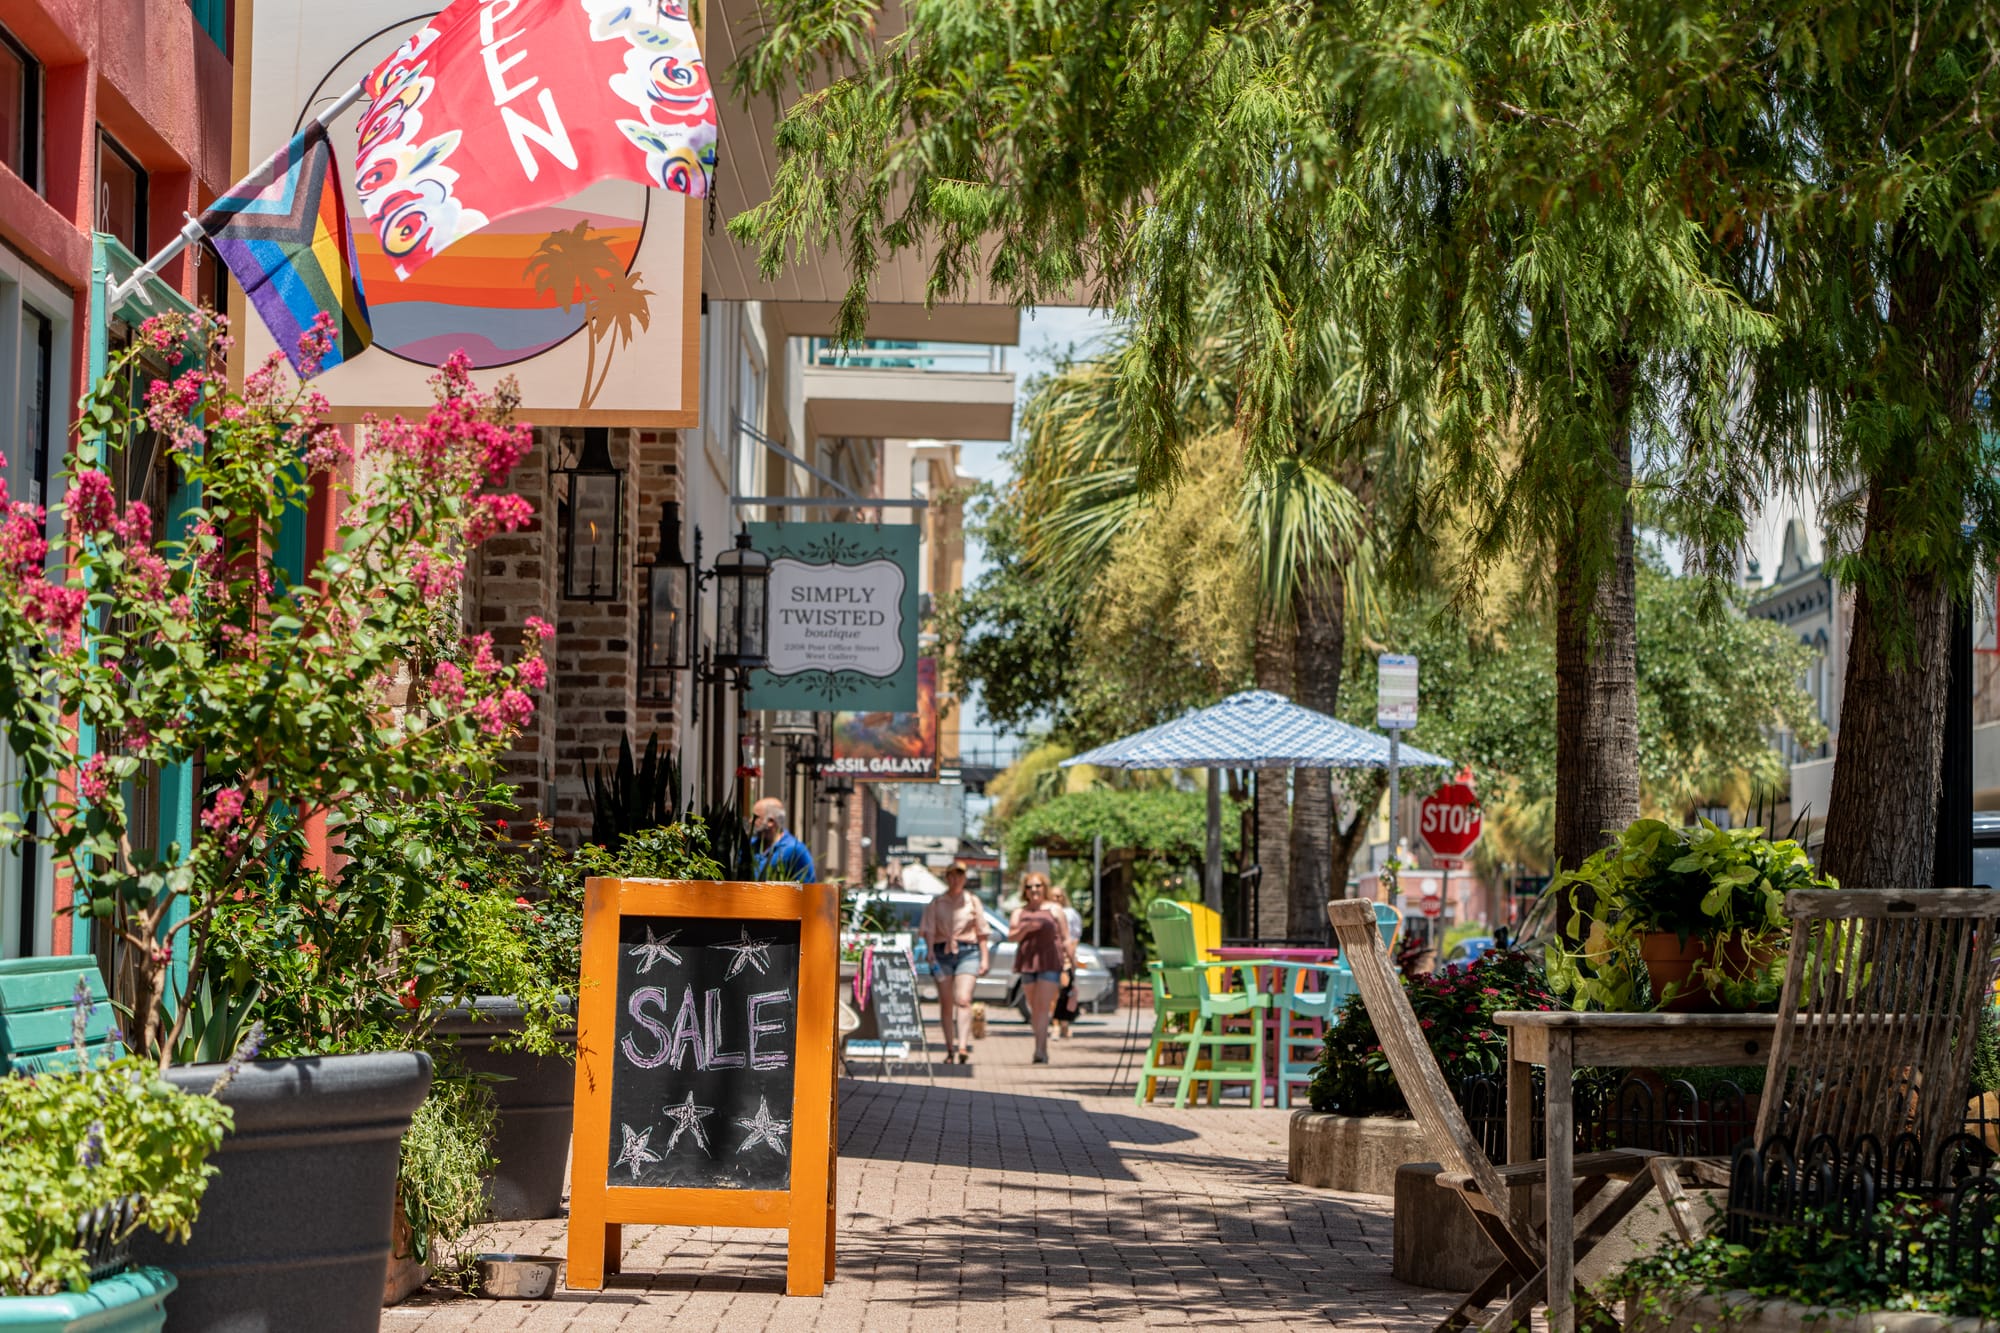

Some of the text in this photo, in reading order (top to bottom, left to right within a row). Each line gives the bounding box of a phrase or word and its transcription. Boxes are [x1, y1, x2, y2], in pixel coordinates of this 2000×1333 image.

[791, 586, 875, 603] SIMPLY
[779, 608, 885, 626] TWISTED
[804, 627, 861, 641] boutique
[808, 643, 825, 651] Post
[828, 643, 852, 652] Office
[855, 644, 880, 652] Street
[828, 653, 858, 661] Gallery
[870, 757, 932, 773] GALAXY
[1422, 803, 1479, 835] STOP
[621, 984, 791, 1071] SALE
